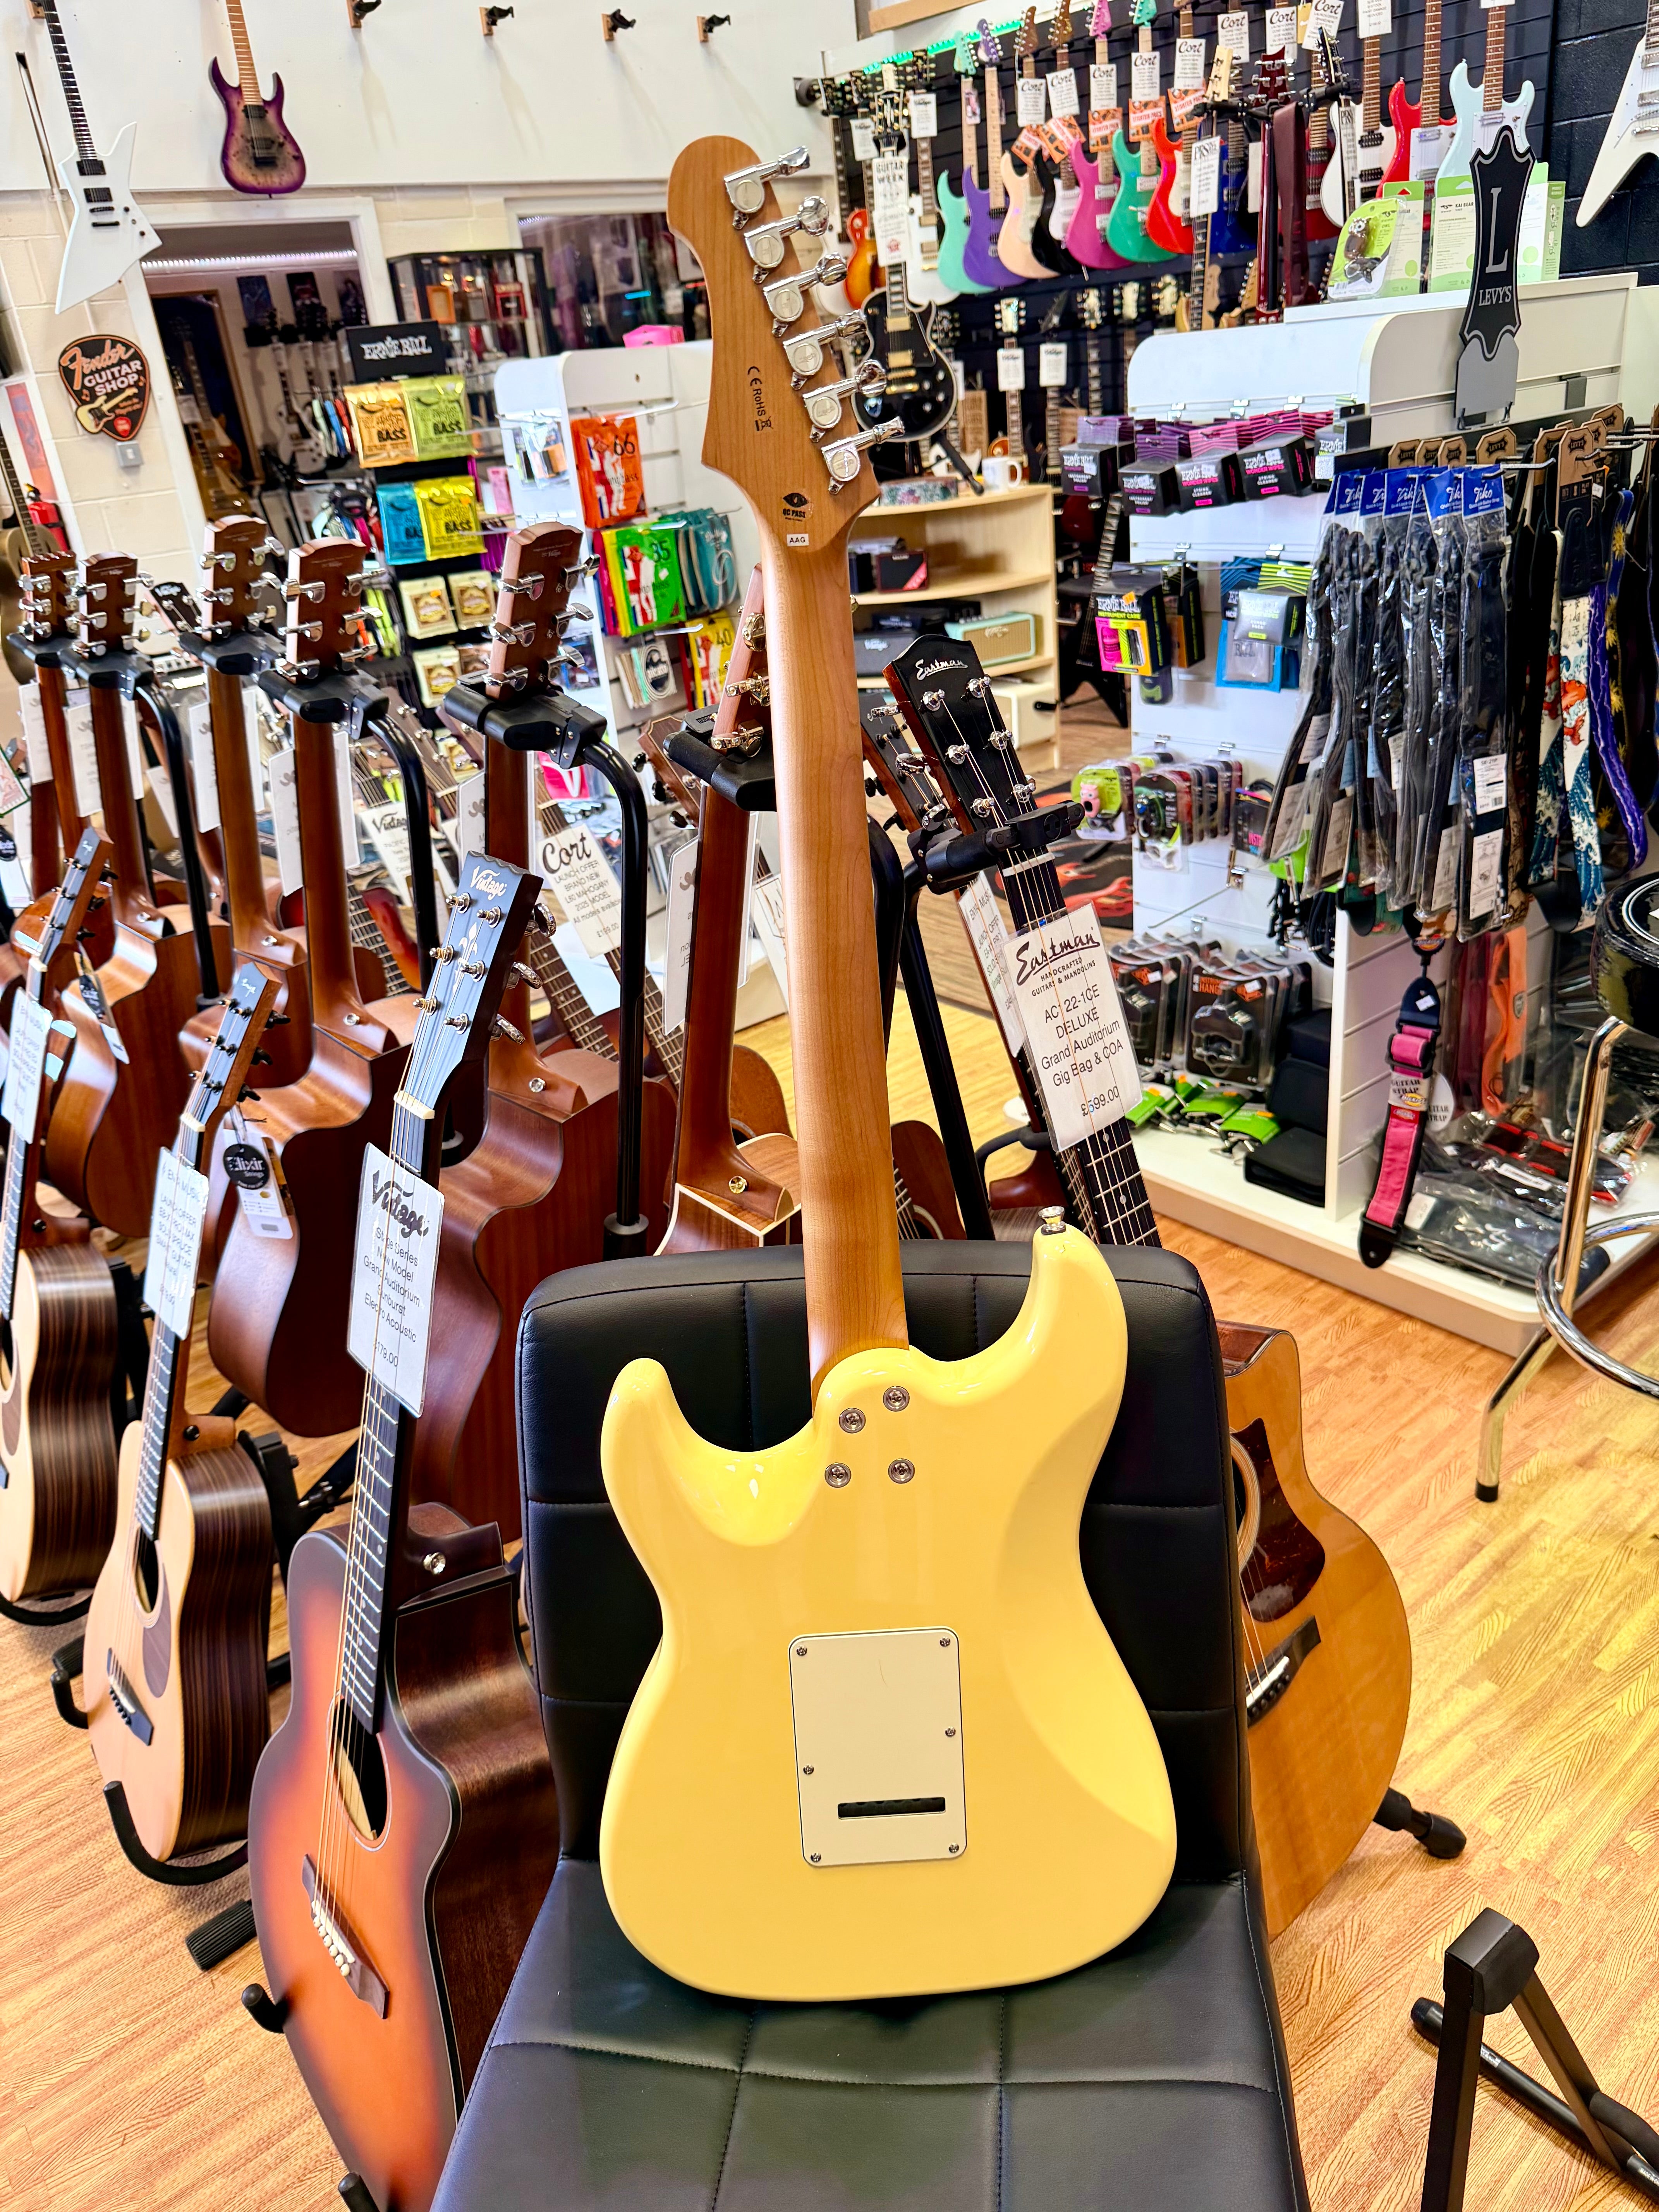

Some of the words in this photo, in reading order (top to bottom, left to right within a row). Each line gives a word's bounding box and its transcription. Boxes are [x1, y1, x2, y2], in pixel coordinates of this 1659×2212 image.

[1270, 10, 1295, 24] Cort
[1314, 0, 1341, 15] Cort
[1221, 15, 1245, 29] Cort
[1179, 41, 1202, 53] Cort
[1134, 54, 1156, 67] Cort
[1051, 73, 1072, 87] Cort
[1093, 67, 1113, 79] Cort
[1022, 81, 1044, 92] Cort
[1486, 187, 1508, 273] L
[1479, 285, 1512, 307] LEVY'S
[360, 335, 402, 360] ERNIE
[402, 336, 432, 356] BALL
[60, 339, 135, 390] Fender
[84, 360, 143, 387] GUITAR
[94, 373, 139, 396] SHOP
[752, 388, 766, 416] RoHS
[377, 428, 406, 443] BASS
[433, 421, 462, 435] BASS
[614, 433, 635, 456] 66
[1319, 438, 1343, 453] ERNIE
[1345, 484, 1360, 503] Tik
[1372, 488, 1385, 503] Ti
[1397, 484, 1413, 503] Tik
[1446, 483, 1462, 502] Tik
[1474, 483, 1493, 503] Tiko
[792, 510, 806, 518] PASS
[405, 527, 423, 539] BA
[445, 520, 472, 533] BASS
[649, 540, 670, 563] 35
[1096, 595, 1119, 611] ERNIE
[915, 659, 969, 680] Eastman
[543, 833, 591, 874] Cort
[580, 860, 599, 872] OFFER
[470, 866, 508, 901] Vintage
[1016, 934, 1100, 986] Eastman
[1041, 957, 1082, 981] HANDCRAFTED
[1032, 980, 1055, 996] GUITARS
[1064, 960, 1096, 981] MANDOLINS
[1056, 1007, 1099, 1039] DELUXE
[1041, 1044, 1071, 1070] Grand
[1074, 1020, 1120, 1053] Auditorium
[1053, 1071, 1070, 1086] Gig
[1070, 1059, 1092, 1077] Bag
[1094, 1051, 1102, 1065] &
[1103, 1039, 1123, 1059] COA
[226, 1156, 265, 1171] Elixir
[372, 1169, 430, 1238] Vintage
[376, 1227, 393, 1250] Stge
[395, 1242, 418, 1267] Series
[392, 1258, 414, 1283] Model
[384, 1272, 420, 1307] Auditorium
[364, 1292, 385, 1319] Elecro
[386, 1312, 416, 1343] Acoustic
